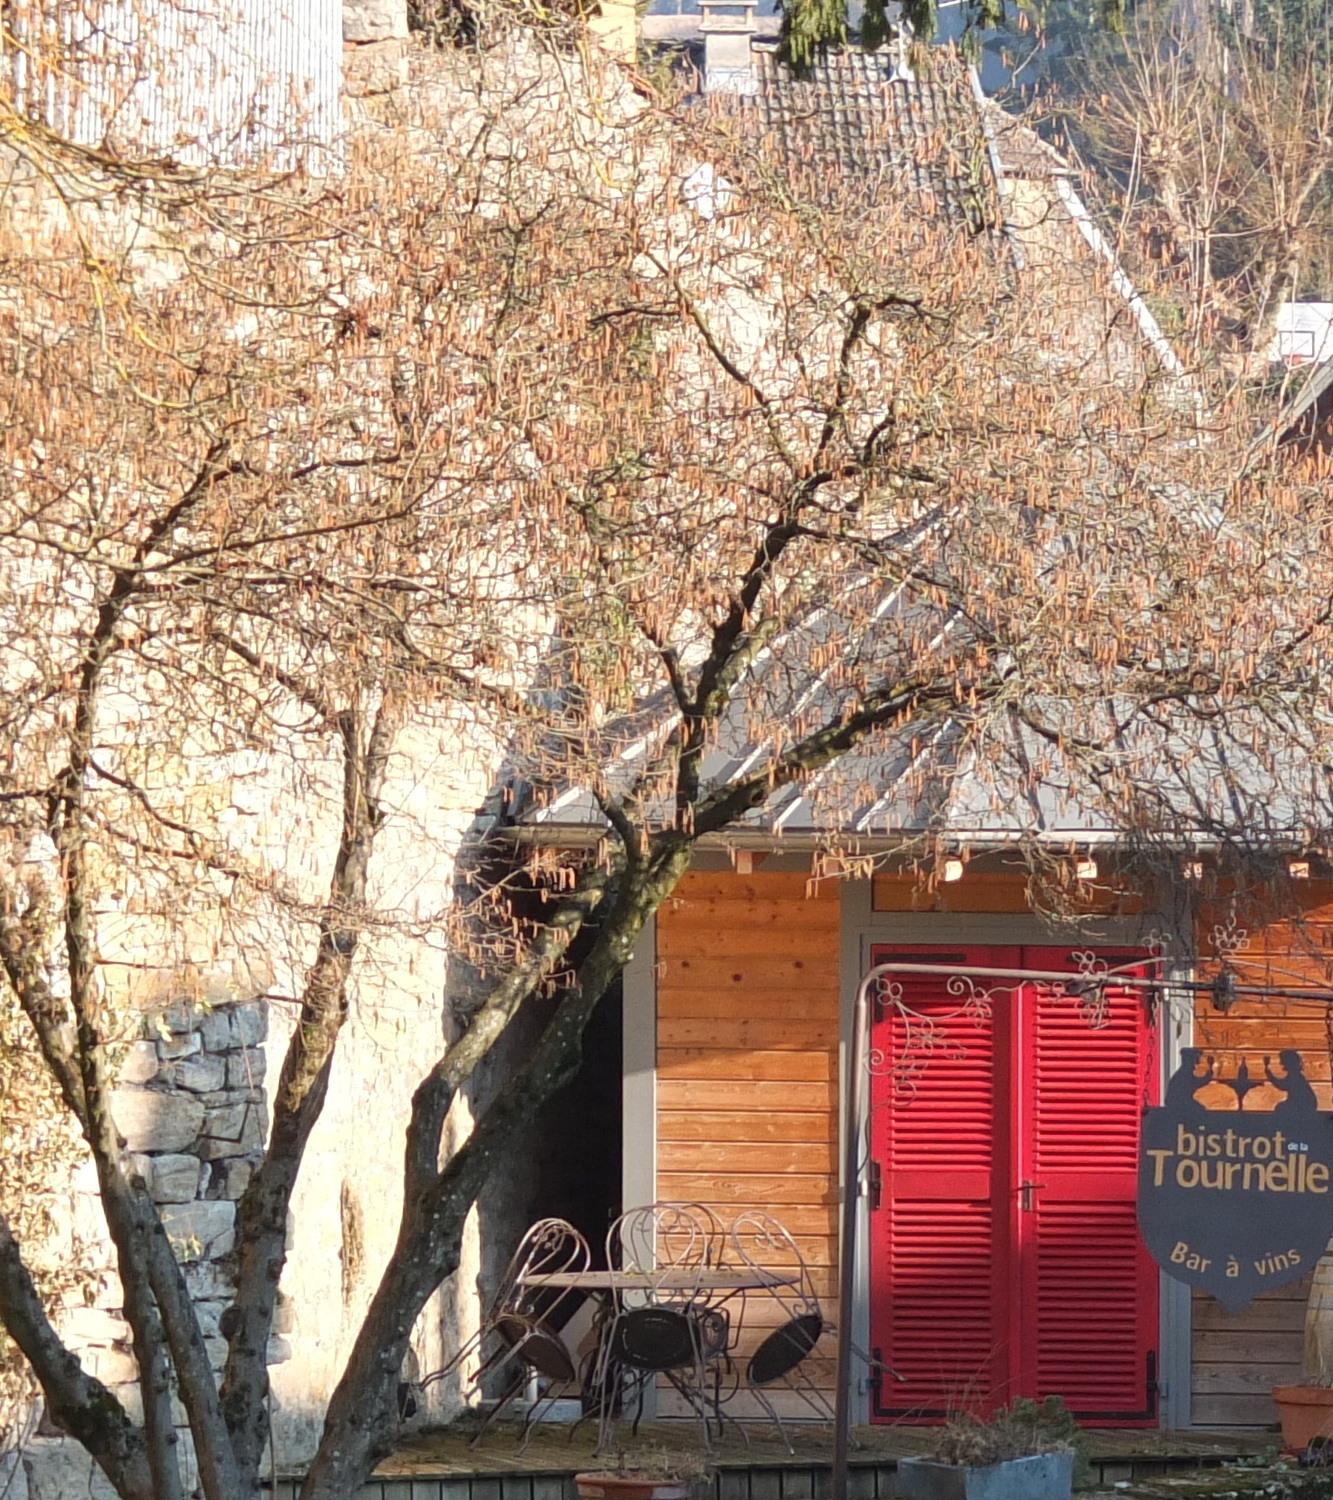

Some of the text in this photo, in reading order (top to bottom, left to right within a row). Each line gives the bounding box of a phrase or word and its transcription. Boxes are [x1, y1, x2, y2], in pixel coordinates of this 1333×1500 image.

[1177, 1124, 1286, 1159] bistrot
[1147, 1150, 1329, 1193] Tournelle
[1170, 1241, 1301, 1277] Bar à vins
